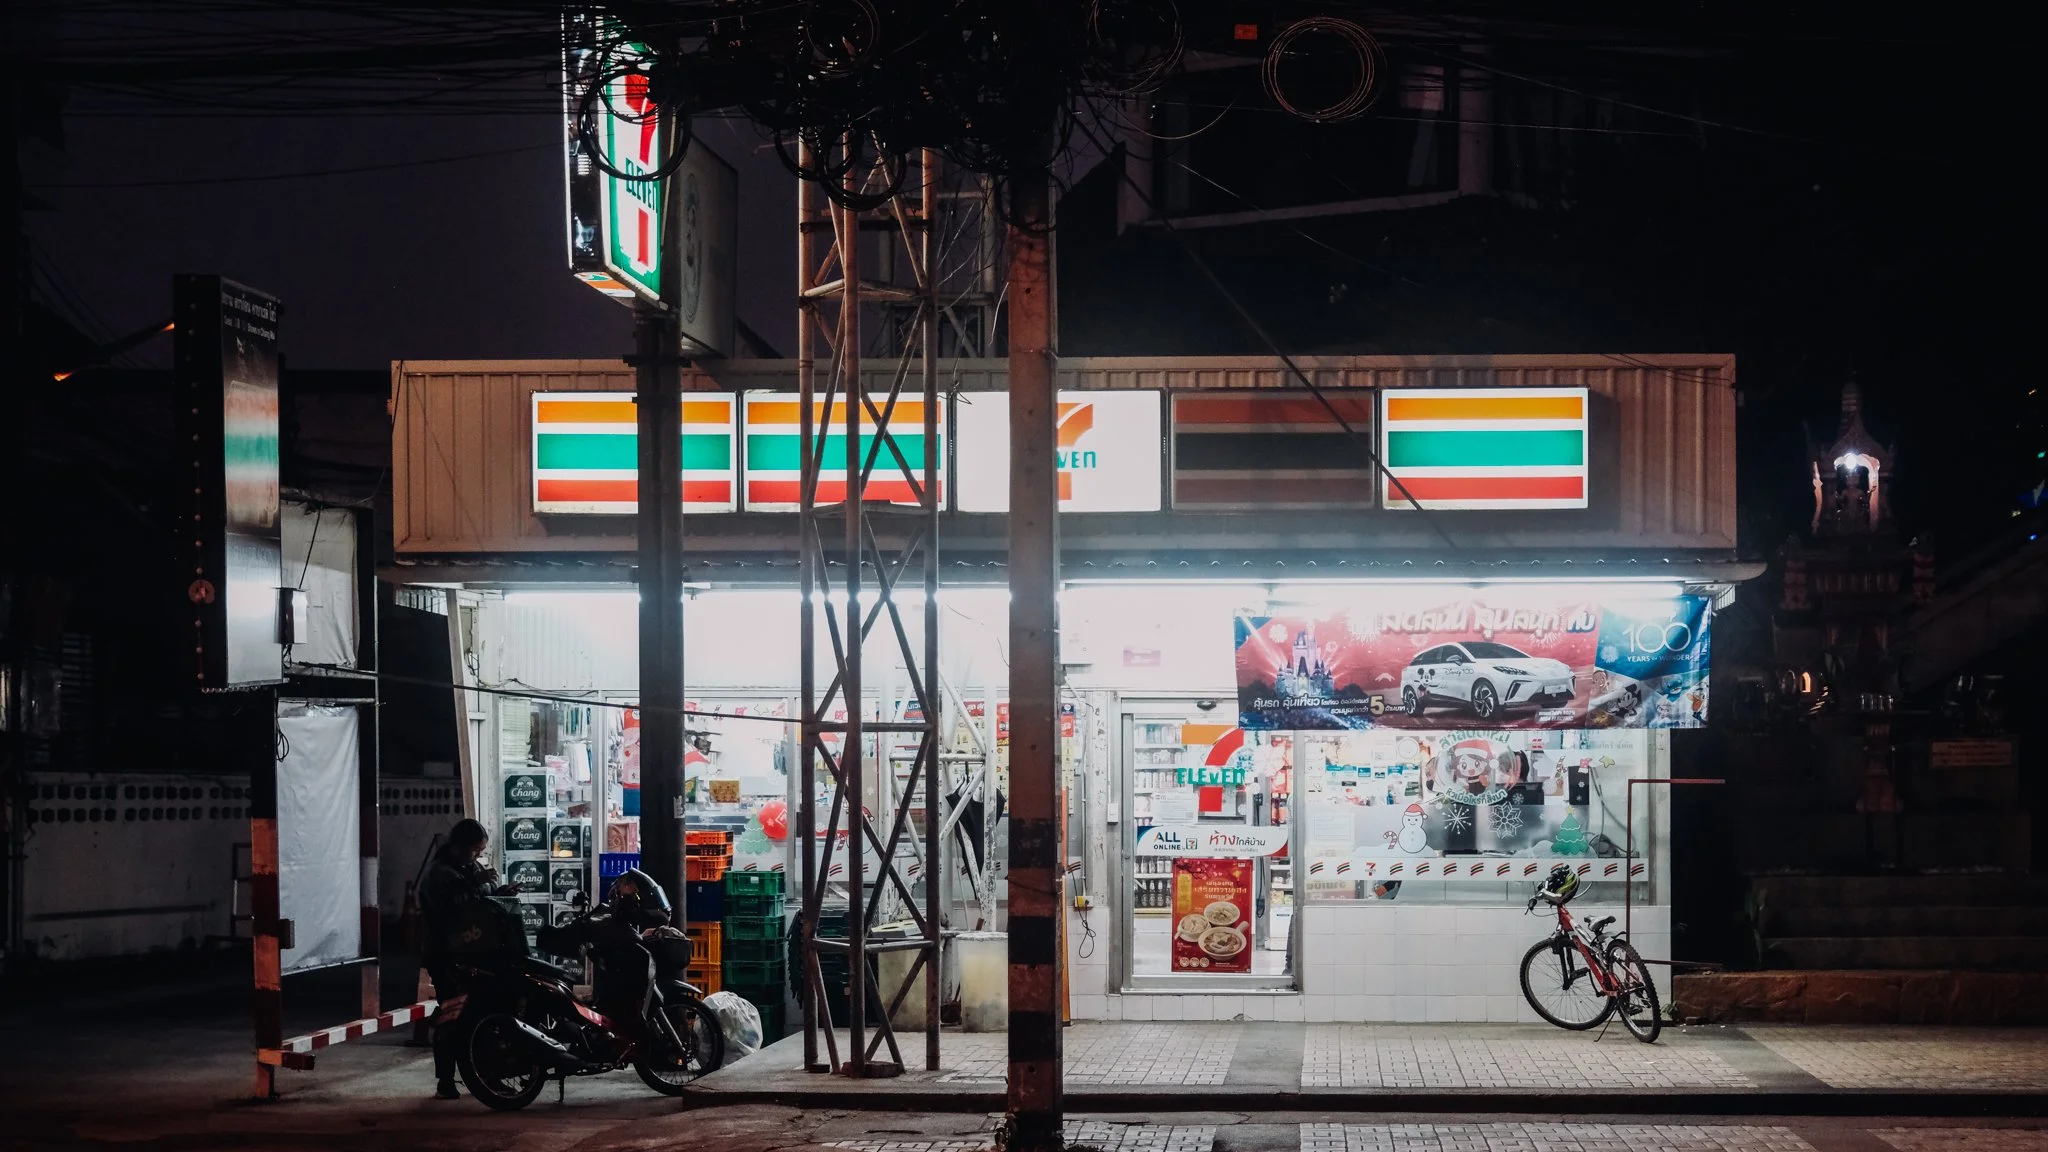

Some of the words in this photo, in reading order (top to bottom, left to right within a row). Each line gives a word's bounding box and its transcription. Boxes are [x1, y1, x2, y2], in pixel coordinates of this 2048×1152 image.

[1622, 622, 1692, 653] 100
[1626, 655, 1651, 663] YEARS
[1253, 697, 1280, 711] ลุ้นรถ
[1283, 693, 1321, 710] ลุ้นเที่ยว
[1370, 695, 1385, 715] 5
[511, 787, 540, 798] Chang
[512, 830, 540, 841] Chang
[554, 835, 577, 843] Chang
[1153, 831, 1181, 843] ALL
[514, 873, 543, 884] Chang
[555, 878, 579, 886] Chang
[523, 917, 543, 926] ang
